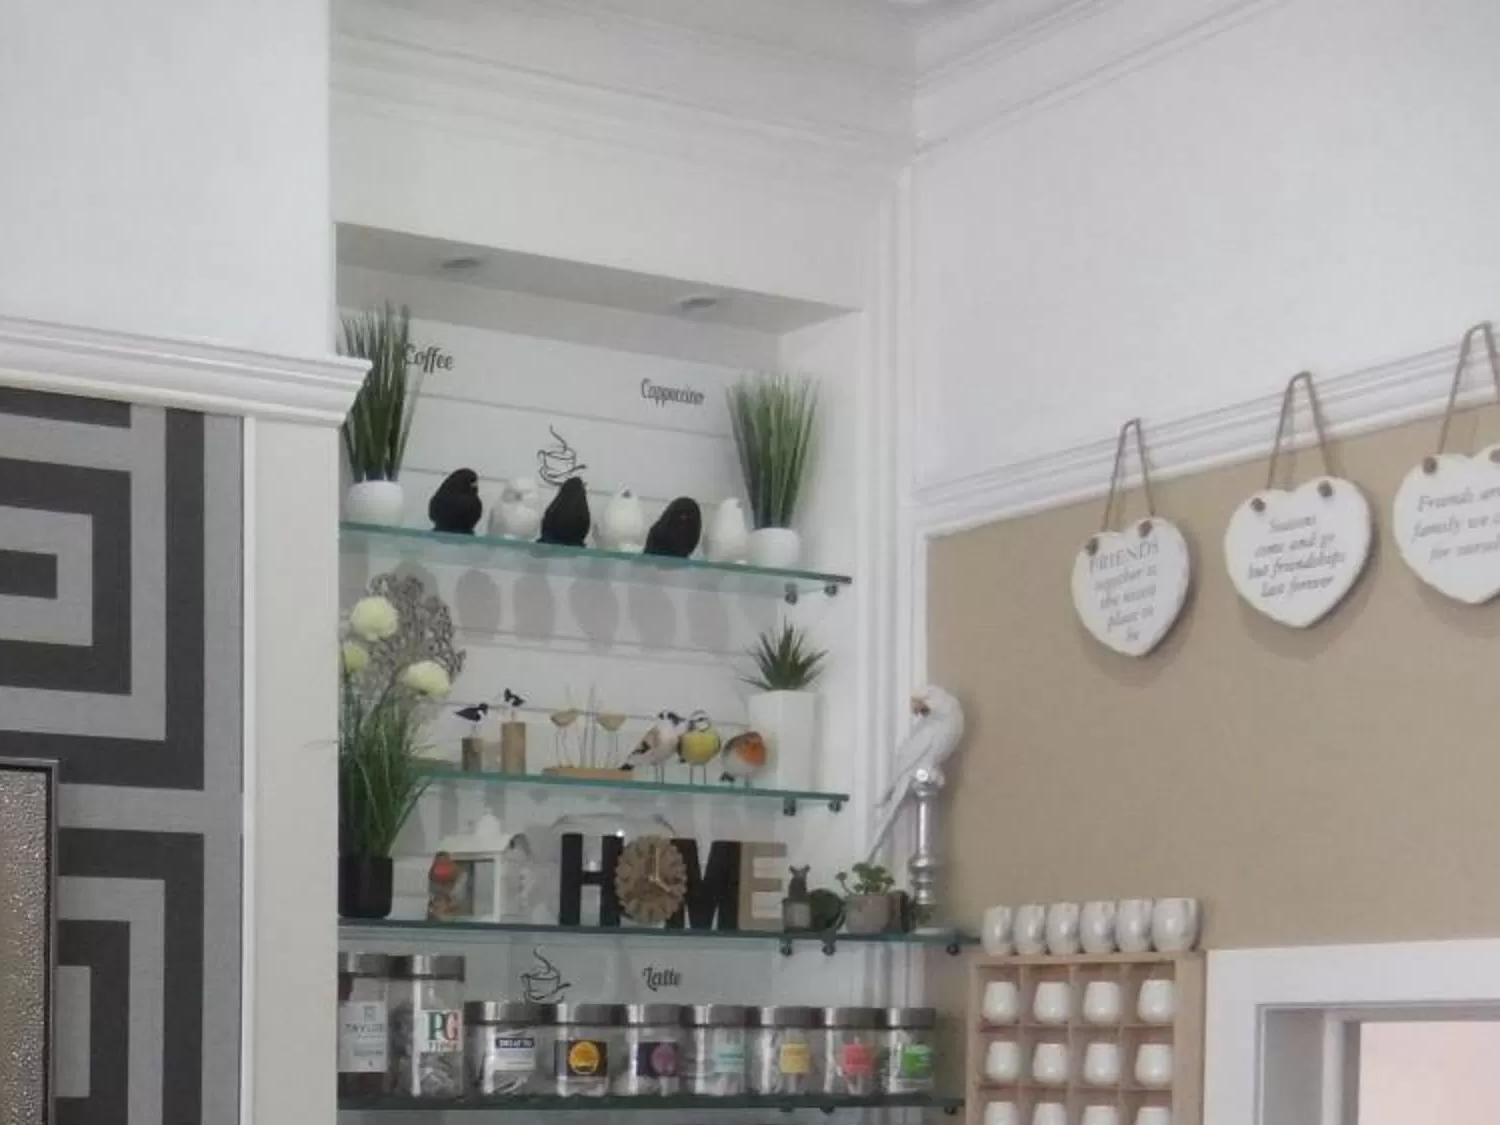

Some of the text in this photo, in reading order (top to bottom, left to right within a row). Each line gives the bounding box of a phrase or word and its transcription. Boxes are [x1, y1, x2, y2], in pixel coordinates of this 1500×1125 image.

[403, 343, 455, 375] Coffee
[642, 966, 681, 992] Latte
[428, 1011, 460, 1041] PG
